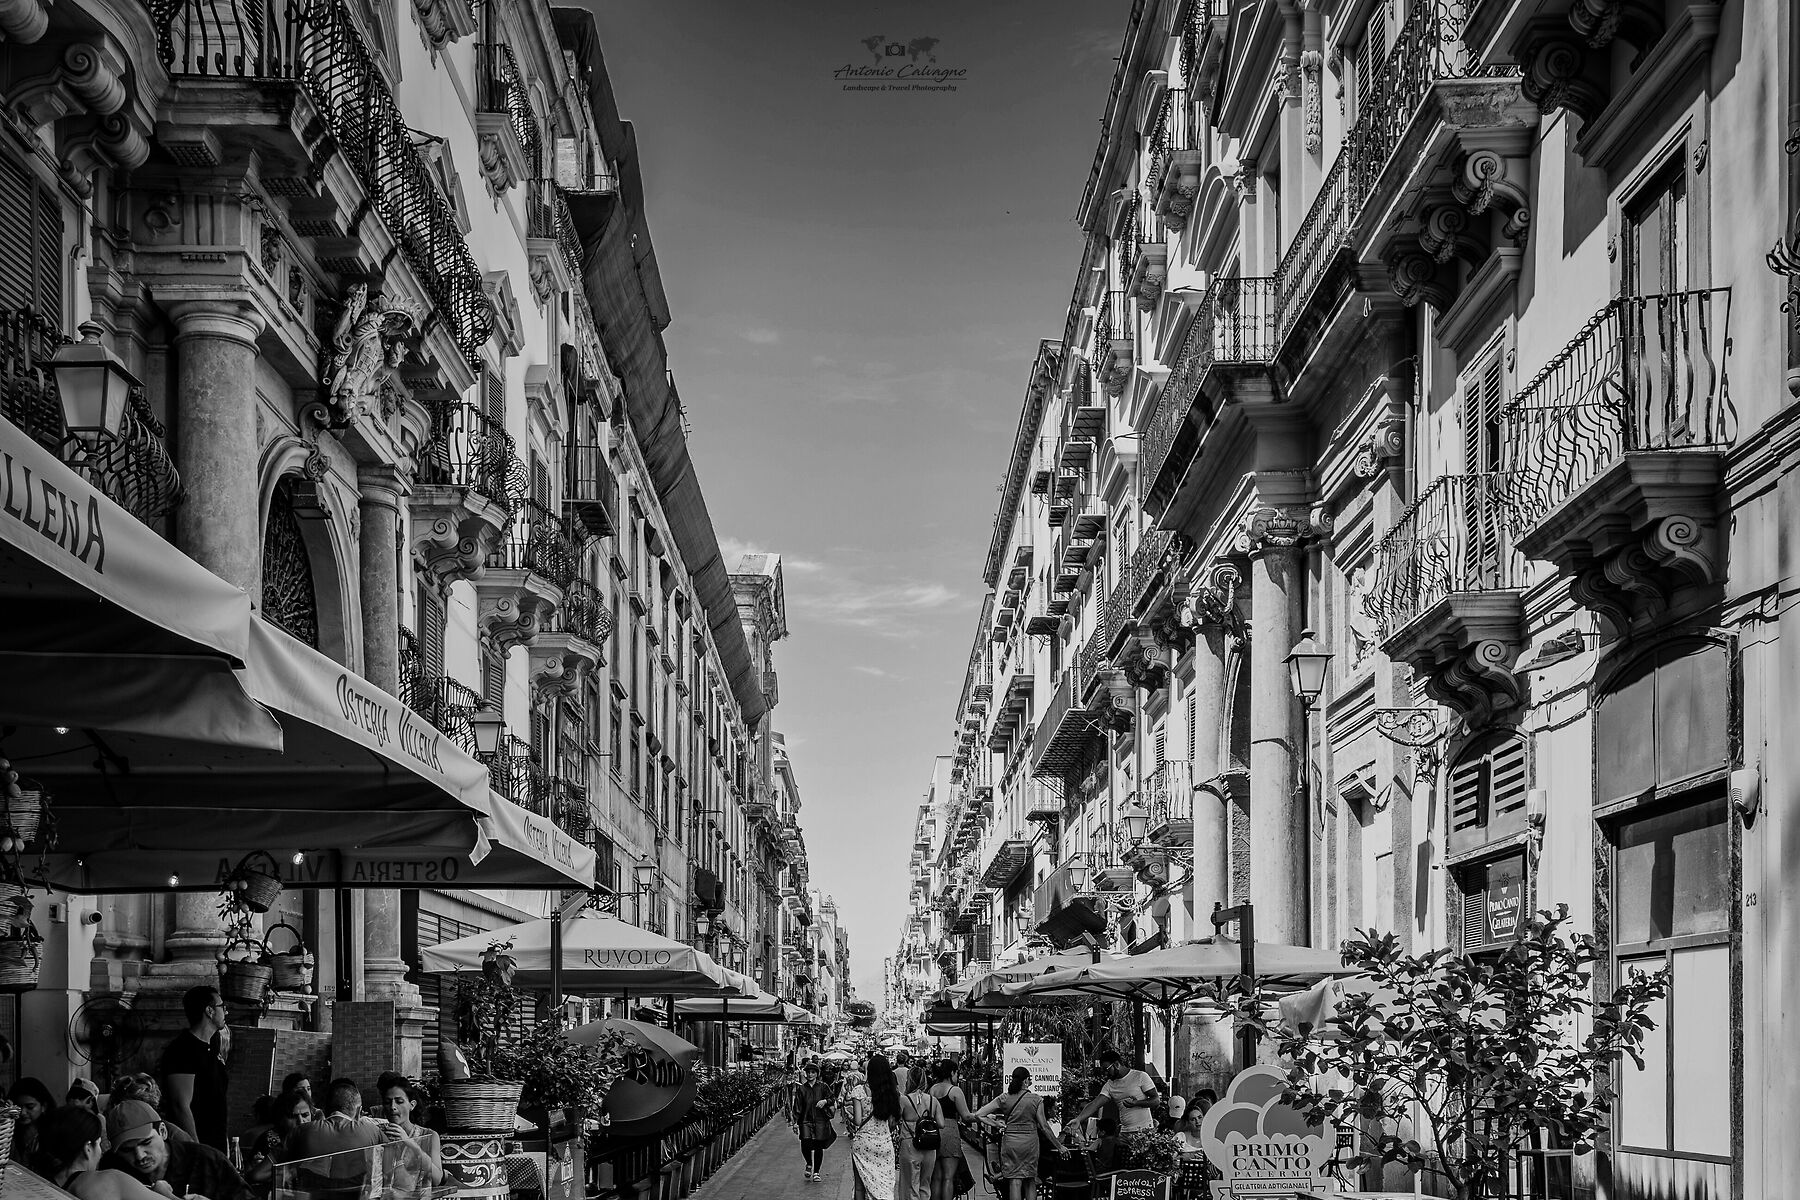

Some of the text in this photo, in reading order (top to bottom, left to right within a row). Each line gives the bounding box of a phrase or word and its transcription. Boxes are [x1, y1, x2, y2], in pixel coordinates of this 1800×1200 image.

[337, 674, 444, 774] OSTERIA VILLENA
[1745, 892, 1757, 907] 213
[584, 948, 672, 968] RUVOLO
[1232, 1142, 1309, 1157] PRIMO
[1232, 1157, 1311, 1171] CANTO
[1234, 1170, 1312, 1178] PALERMO
[1234, 1182, 1309, 1191] GELATERIA ARTIGIANALE
